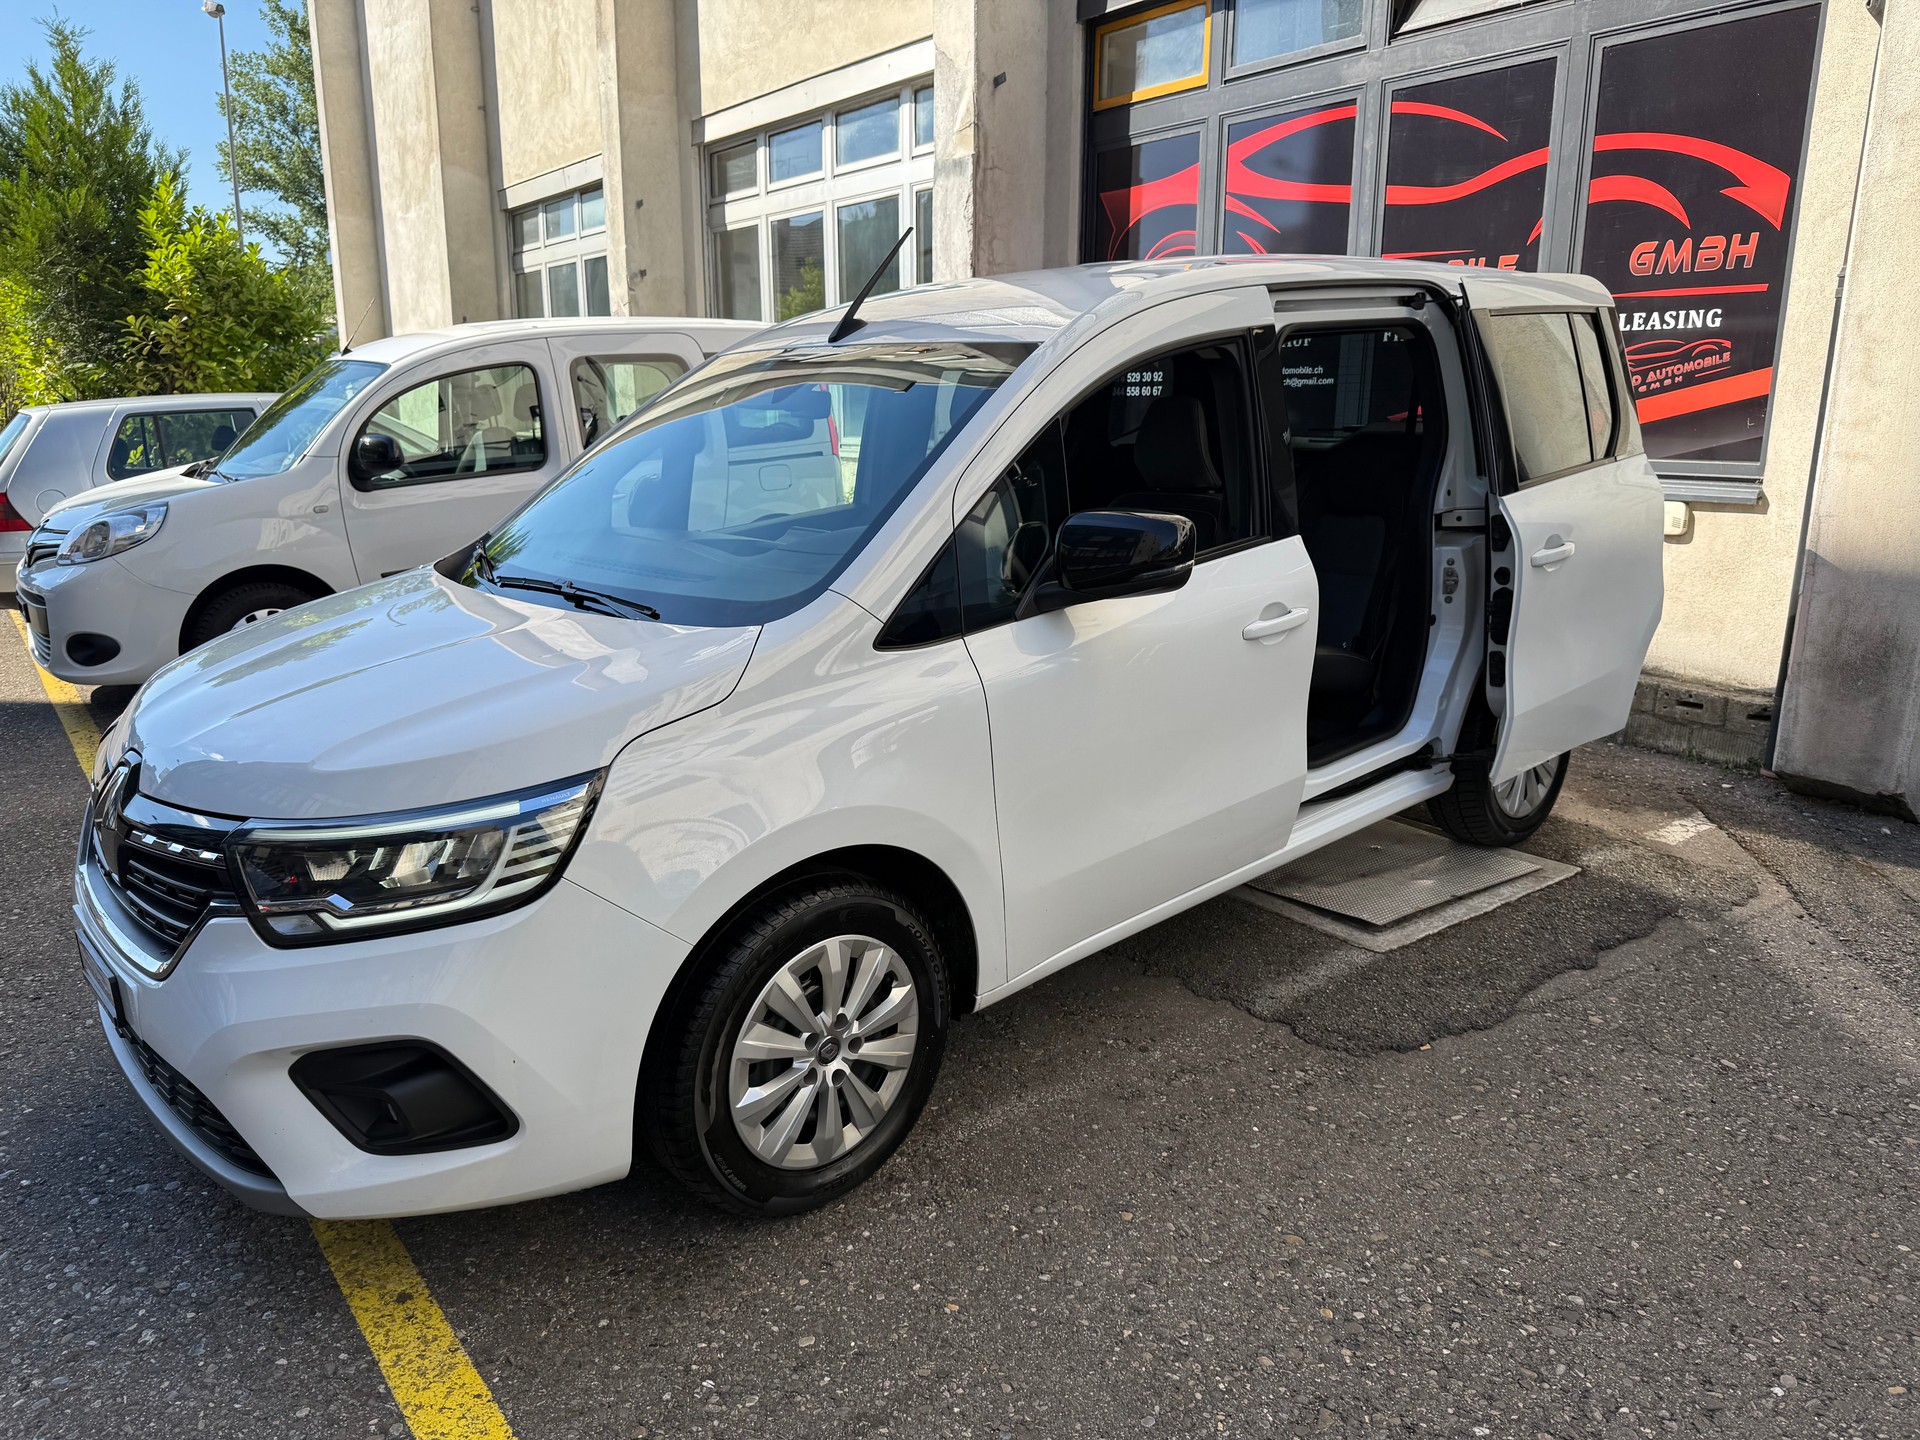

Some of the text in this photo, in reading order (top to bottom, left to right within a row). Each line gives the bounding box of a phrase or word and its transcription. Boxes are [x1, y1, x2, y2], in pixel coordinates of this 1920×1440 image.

[1629, 232, 1760, 276] GMBH
[1618, 308, 1723, 332] LEASING
[1126, 372, 1141, 383] 529
[1141, 371, 1152, 382] 30
[1152, 371, 1164, 382] 92
[1646, 351, 1731, 383] AUTOMOBILE
[1125, 386, 1140, 397] 558
[1140, 385, 1151, 397] 60
[1152, 385, 1163, 396] 67
